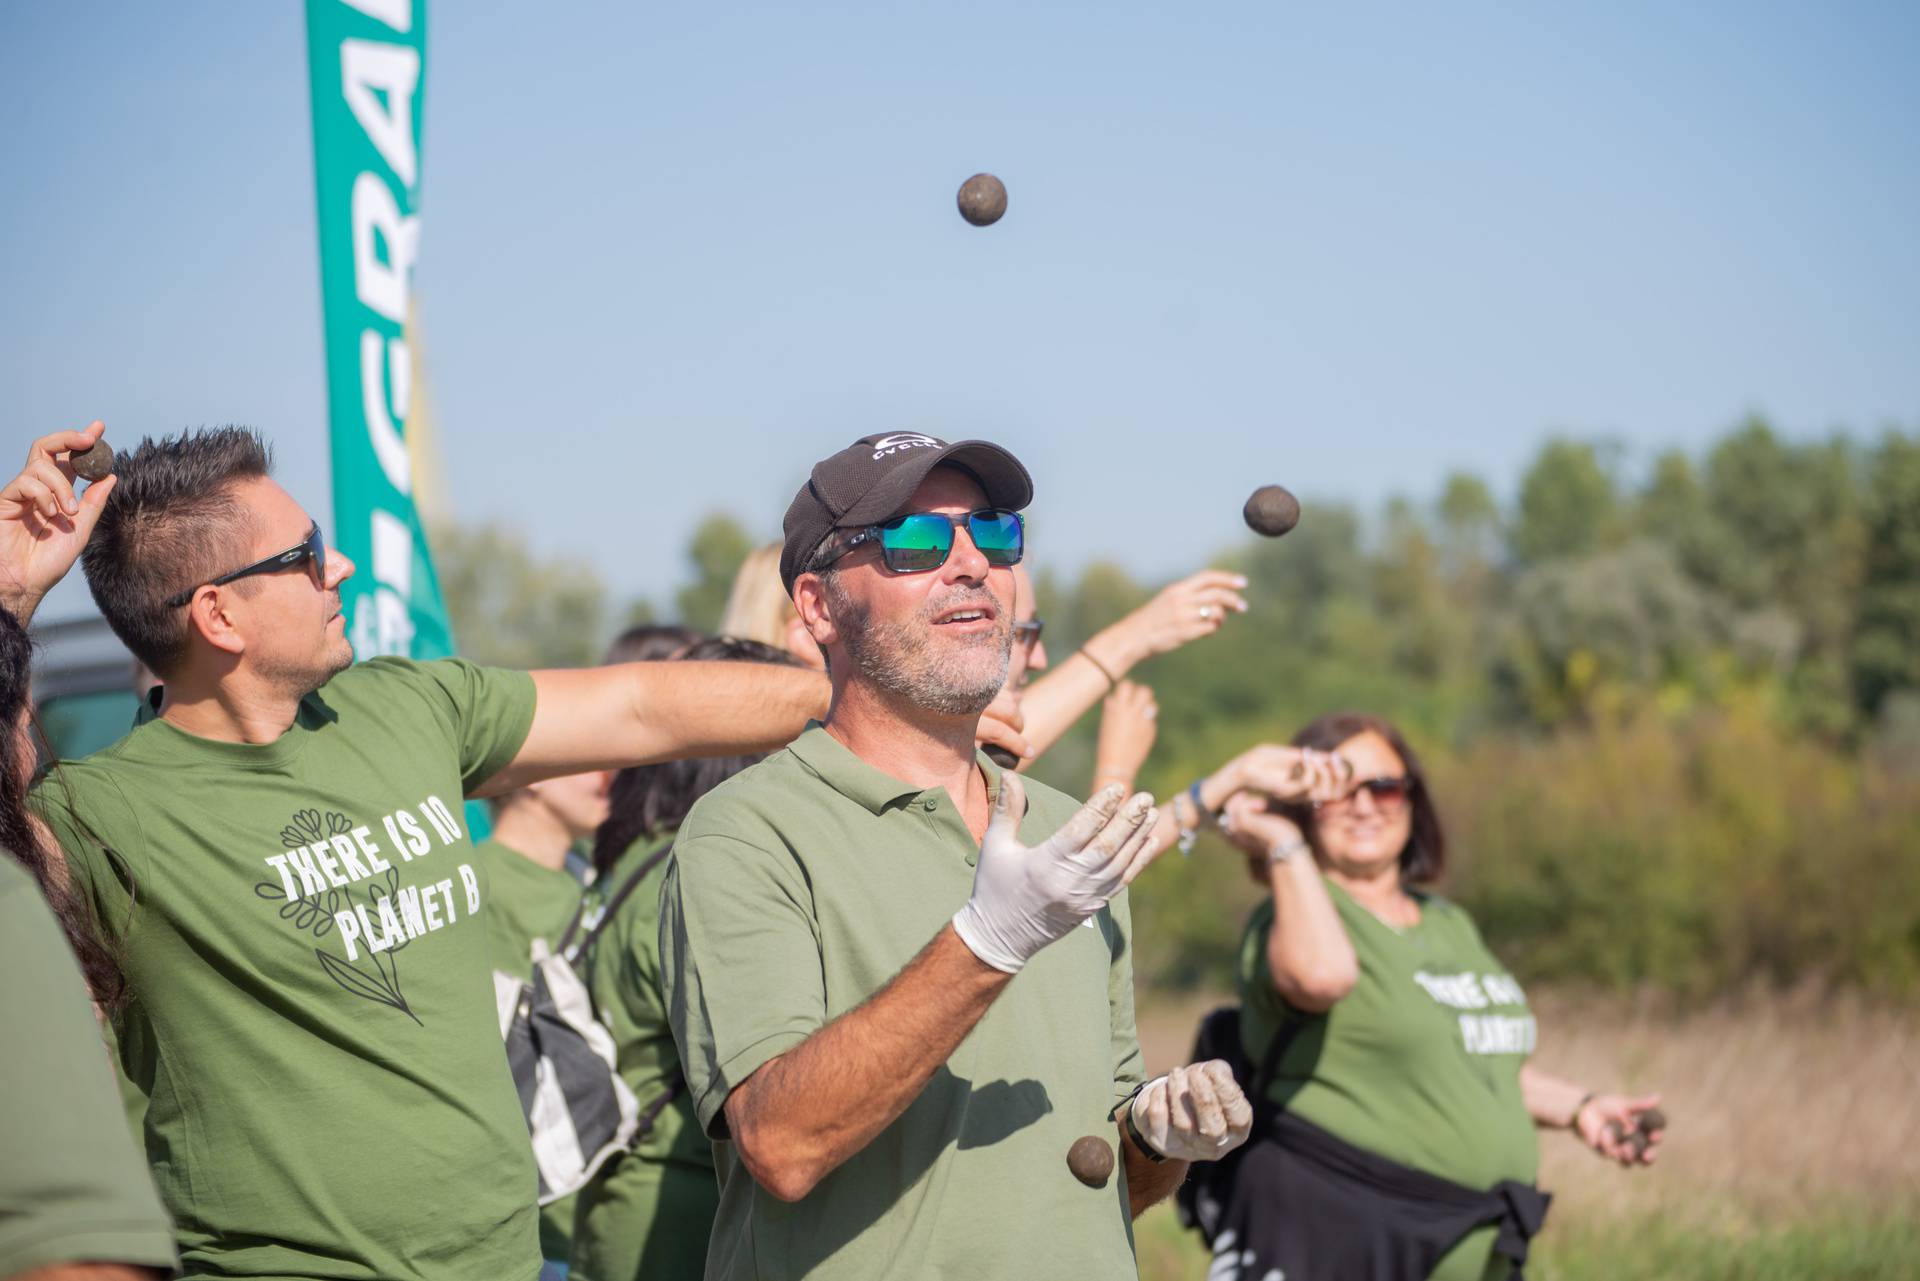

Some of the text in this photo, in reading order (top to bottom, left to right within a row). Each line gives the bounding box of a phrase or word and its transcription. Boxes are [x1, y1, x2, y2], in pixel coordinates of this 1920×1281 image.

[264, 825, 391, 902] THERE
[382, 809, 431, 862] IS
[333, 878, 456, 962] PLANET
